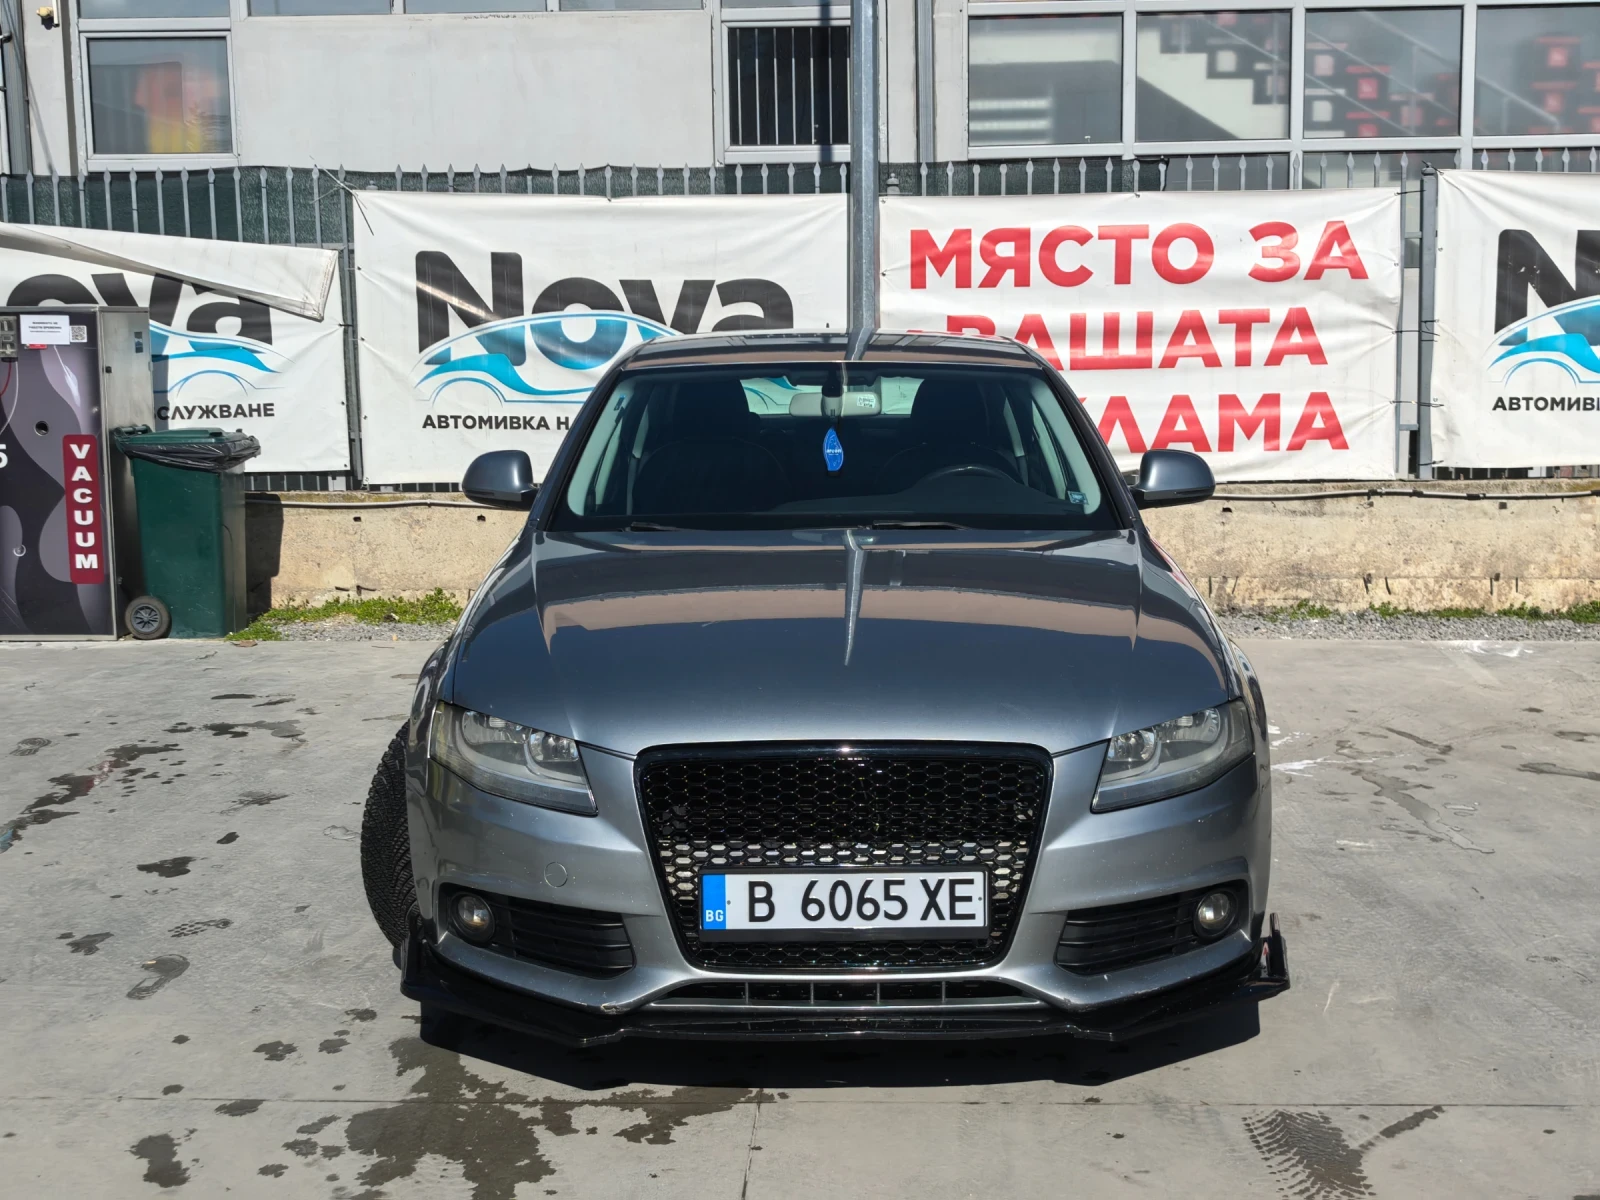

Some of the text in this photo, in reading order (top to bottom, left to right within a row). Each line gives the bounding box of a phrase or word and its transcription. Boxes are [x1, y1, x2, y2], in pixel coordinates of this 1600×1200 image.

[910, 220, 1369, 290] МЯСТО ЗА
[154, 402, 275, 420] СЛУЖВАНЕ
[1492, 396, 1600, 411] АВТОМИВ
[422, 414, 570, 430] АВТОМИВКА Н
[1081, 391, 1349, 454] ЛАМА
[69, 443, 98, 569] VACUUM
[705, 909, 724, 922] BG
[748, 878, 976, 922] B 6065 XE
